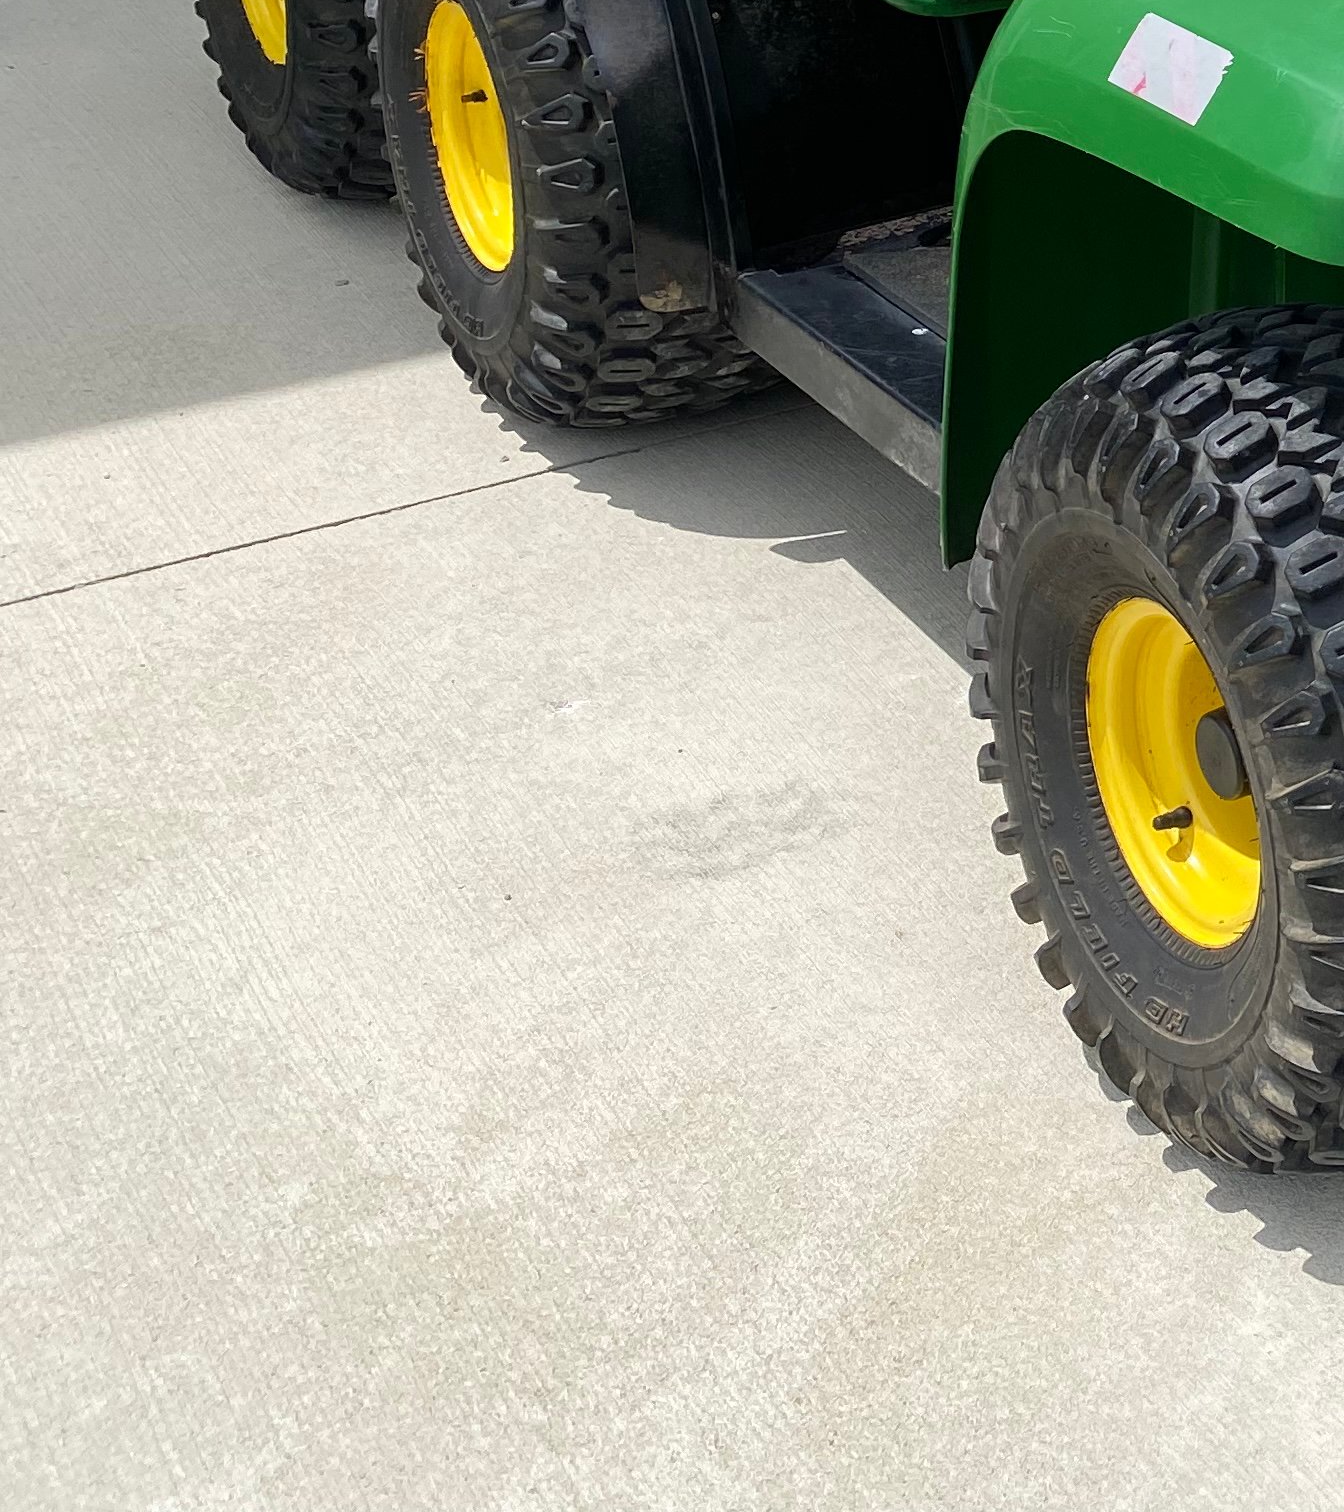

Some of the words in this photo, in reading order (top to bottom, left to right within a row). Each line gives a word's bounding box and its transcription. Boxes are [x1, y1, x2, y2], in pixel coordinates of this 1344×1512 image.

[1015, 654, 1055, 829] TRAX
[1051, 847, 1138, 999] FIELD
[1144, 996, 1190, 1037] HD
